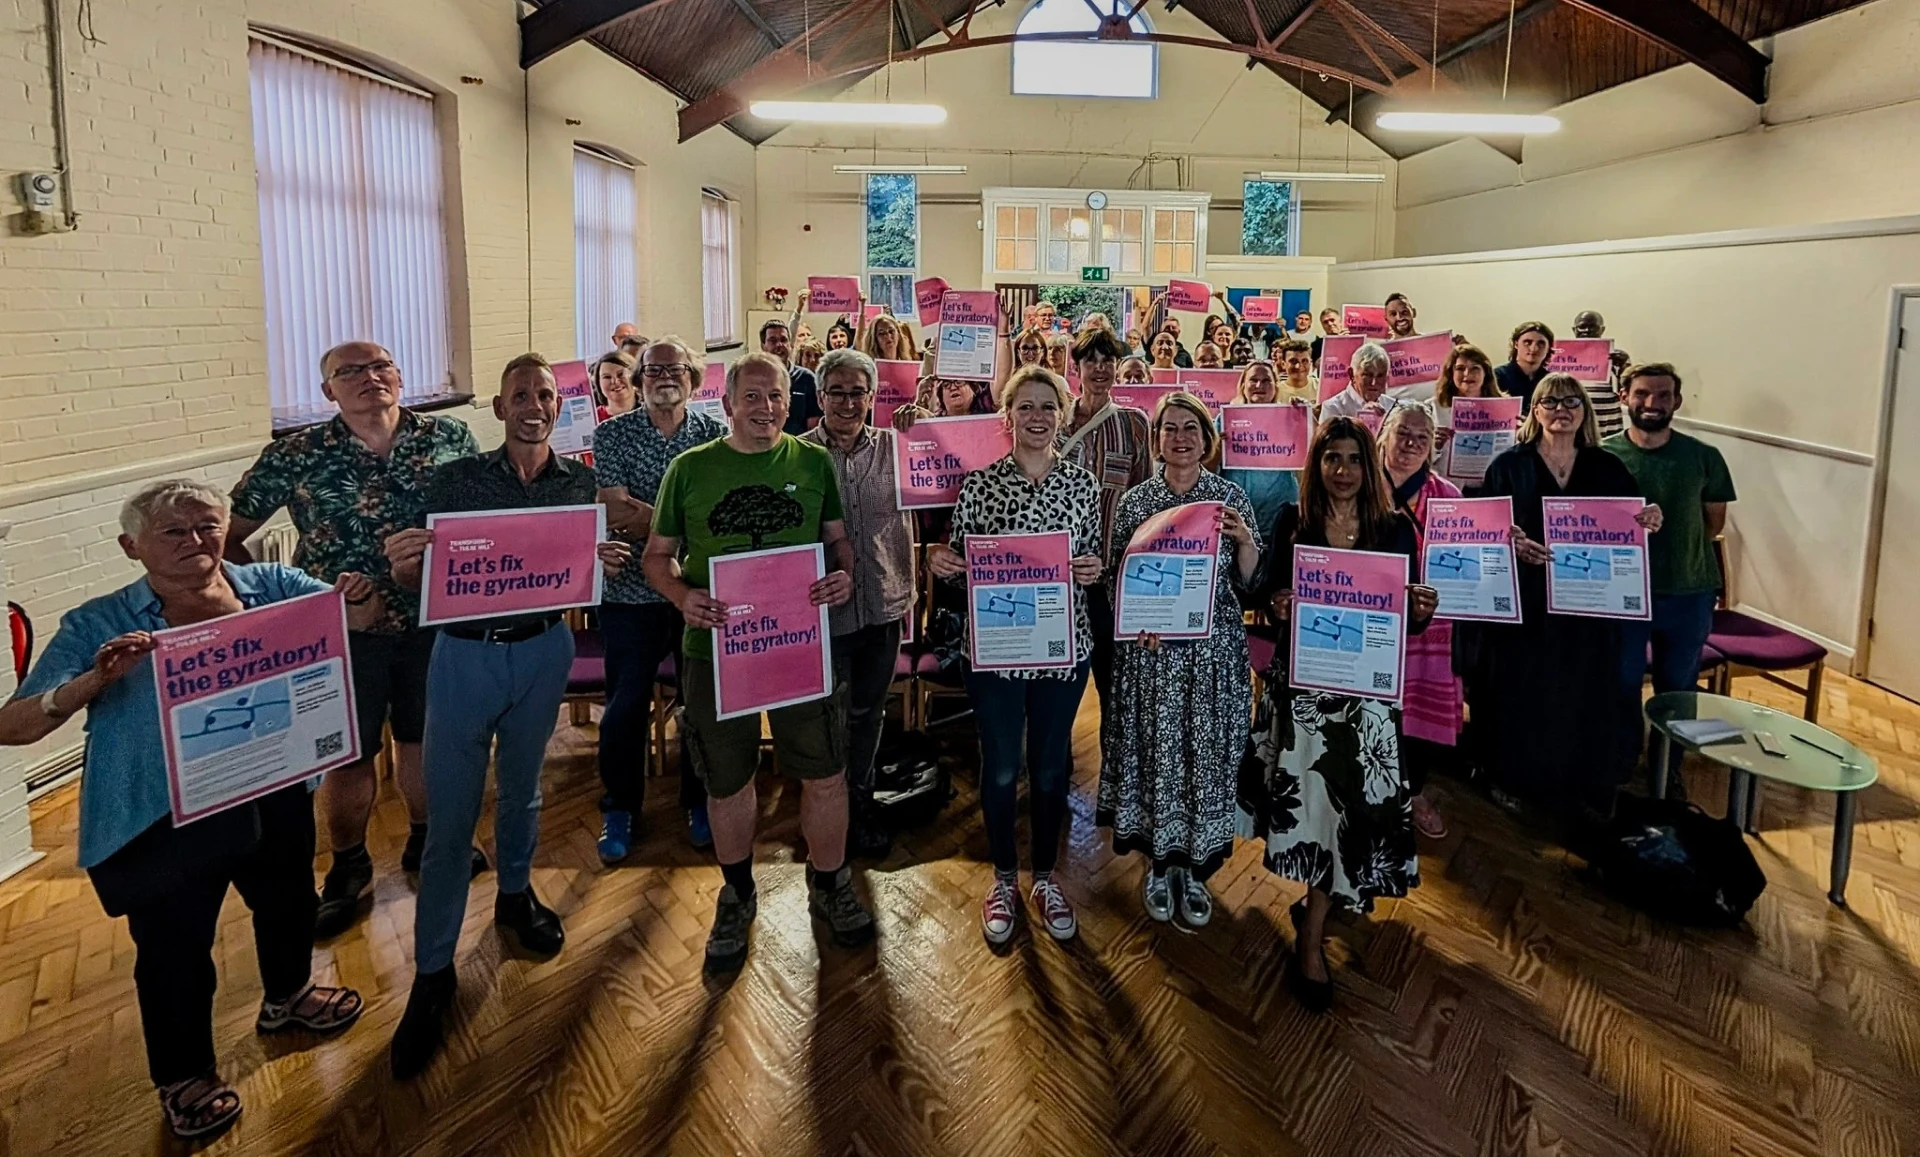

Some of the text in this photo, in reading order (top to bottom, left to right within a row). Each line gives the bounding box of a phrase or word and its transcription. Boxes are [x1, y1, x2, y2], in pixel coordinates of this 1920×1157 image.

[943, 302, 961, 312] Let's
[962, 302, 972, 311] fix
[942, 312, 993, 323] the gyratory!
[1391, 356, 1421, 368] Let's fix
[1568, 355, 1577, 363] fix
[1392, 369, 1404, 377] the
[1562, 364, 1599, 373] gyratory!
[1204, 390, 1214, 399] fix
[1232, 430, 1269, 442] Let's fix
[1232, 442, 1295, 457] the gyratory!
[909, 454, 961, 471] Let's fix
[910, 473, 964, 489] the gyra
[1430, 516, 1475, 528] Let's fix
[1549, 515, 1597, 527] Let's fix
[1429, 530, 1504, 542] the gyratory!
[1549, 528, 1635, 544] the gyratory!
[1149, 536, 1210, 552] gyratory!
[448, 555, 524, 576] Let's fix
[971, 552, 1022, 566] Let's fix
[972, 565, 1059, 583] the gyratory!
[1298, 568, 1353, 587] Let's fix
[446, 568, 570, 596] the gyratory!
[1298, 584, 1393, 610] the gyratory!
[724, 616, 778, 638] Let's fix
[725, 625, 817, 655] the gyratory!
[165, 637, 263, 677] Let's fix
[167, 637, 327, 698] the gyratory!
